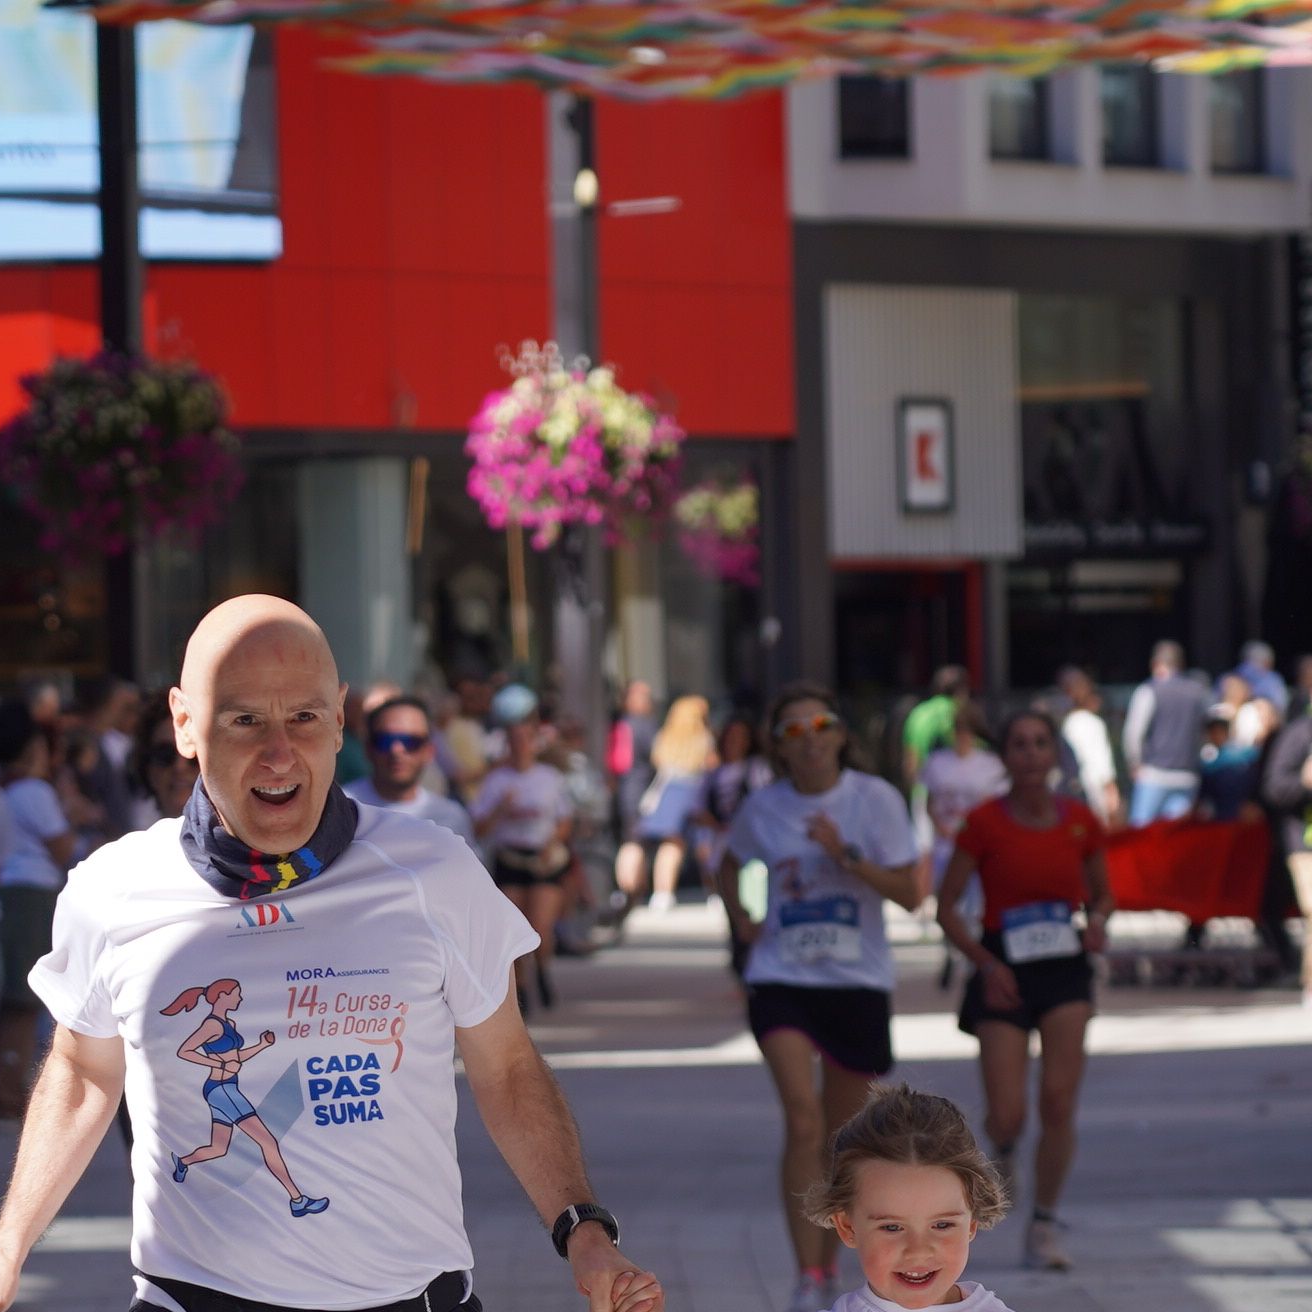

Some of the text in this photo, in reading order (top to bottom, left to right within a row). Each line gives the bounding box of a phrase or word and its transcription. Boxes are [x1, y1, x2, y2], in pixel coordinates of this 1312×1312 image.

[235, 901, 296, 929] ADA
[286, 967, 337, 982] MORA
[287, 985, 391, 1019] 14a Cursa
[288, 1015, 388, 1039] de la Dona
[306, 1052, 381, 1075] CADA
[308, 1073, 381, 1101] PAS
[313, 1099, 384, 1127] SUMA
